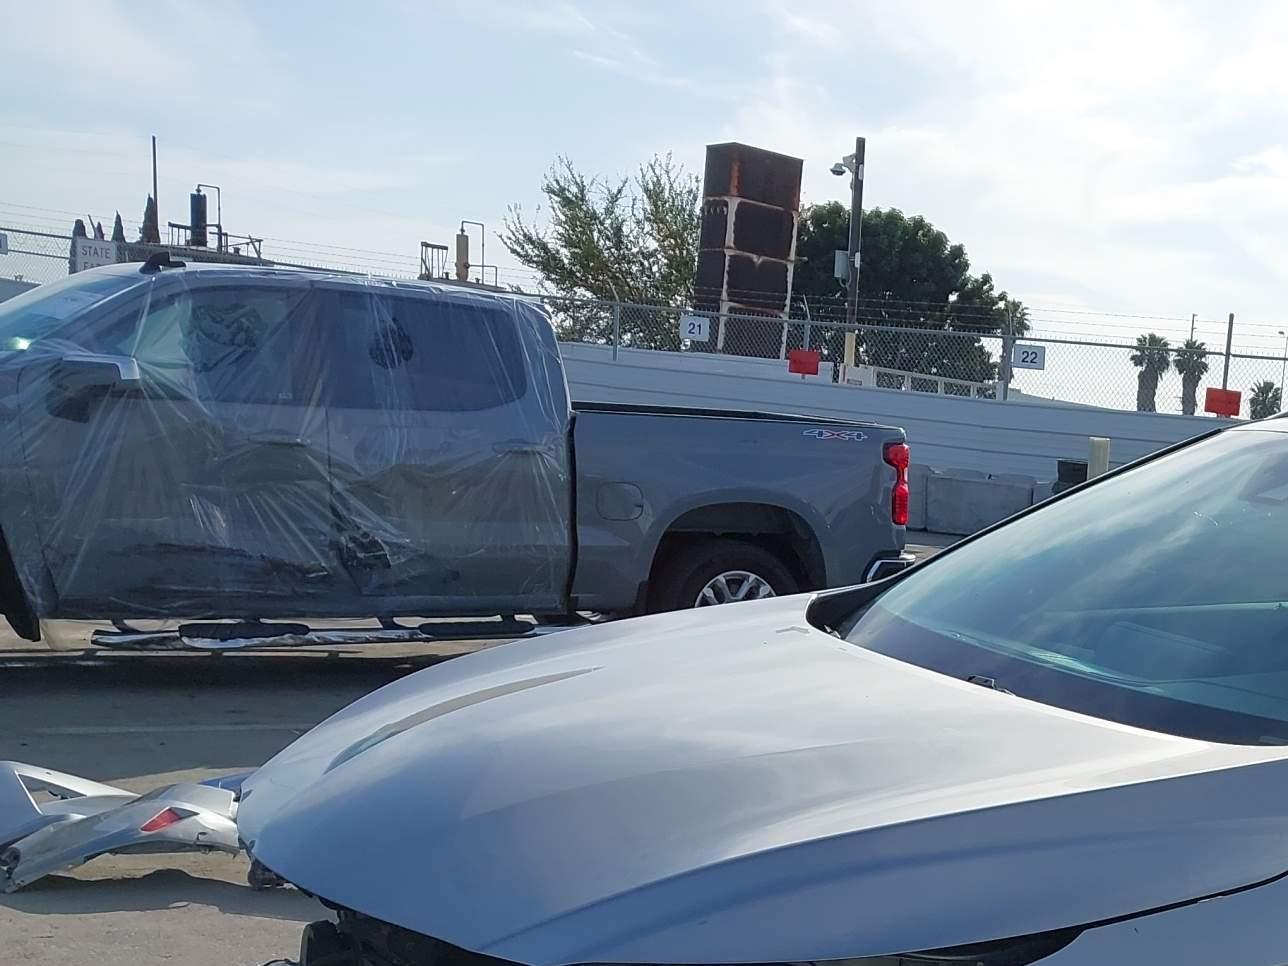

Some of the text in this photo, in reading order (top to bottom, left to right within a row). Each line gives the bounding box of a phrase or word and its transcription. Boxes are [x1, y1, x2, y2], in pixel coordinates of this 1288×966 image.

[81, 246, 111, 259] STATE
[687, 322, 702, 335] 21
[1021, 350, 1038, 364] 22
